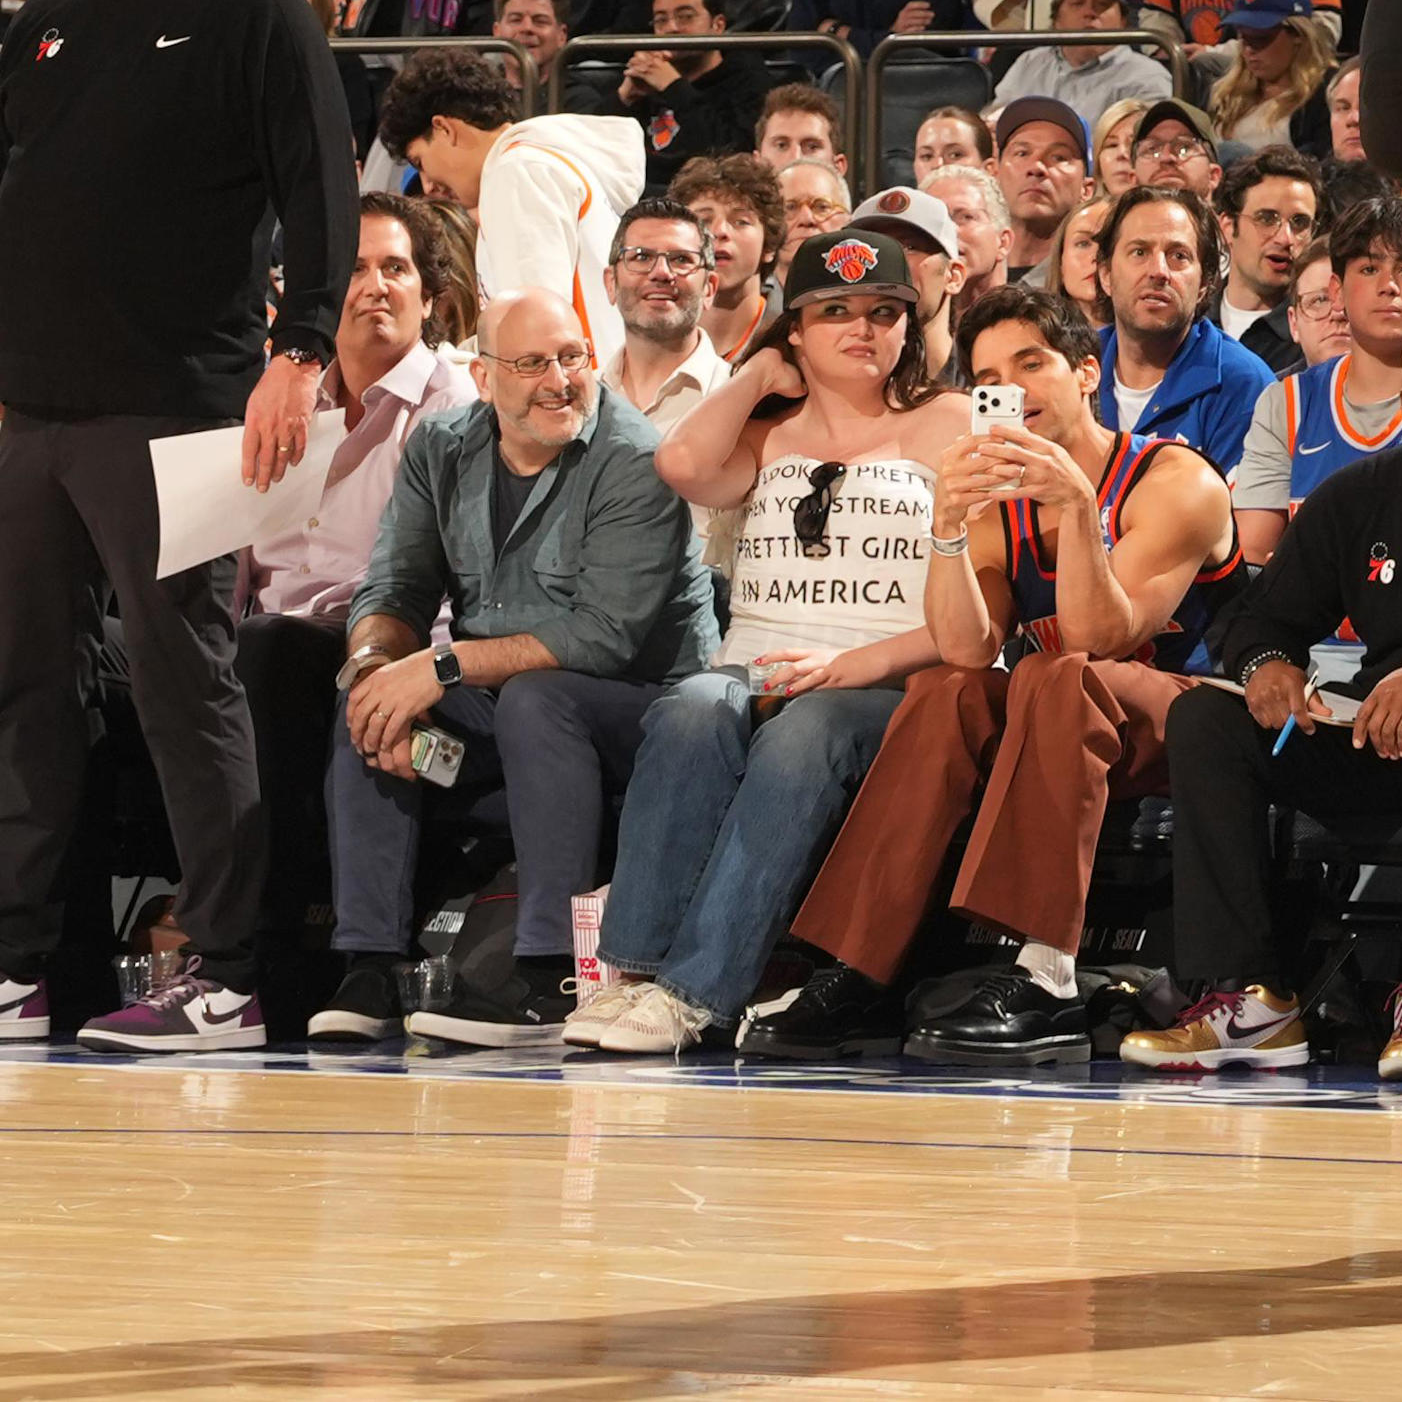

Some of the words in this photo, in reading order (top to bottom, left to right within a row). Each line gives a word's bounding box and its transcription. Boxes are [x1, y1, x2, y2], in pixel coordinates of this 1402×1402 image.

[832, 497, 930, 519] STREAM
[737, 536, 850, 559] PRETTIEST
[862, 537, 924, 559] GIRL
[741, 579, 760, 603] IN
[765, 579, 906, 604] AMERICA
[425, 911, 466, 934] SECTION
